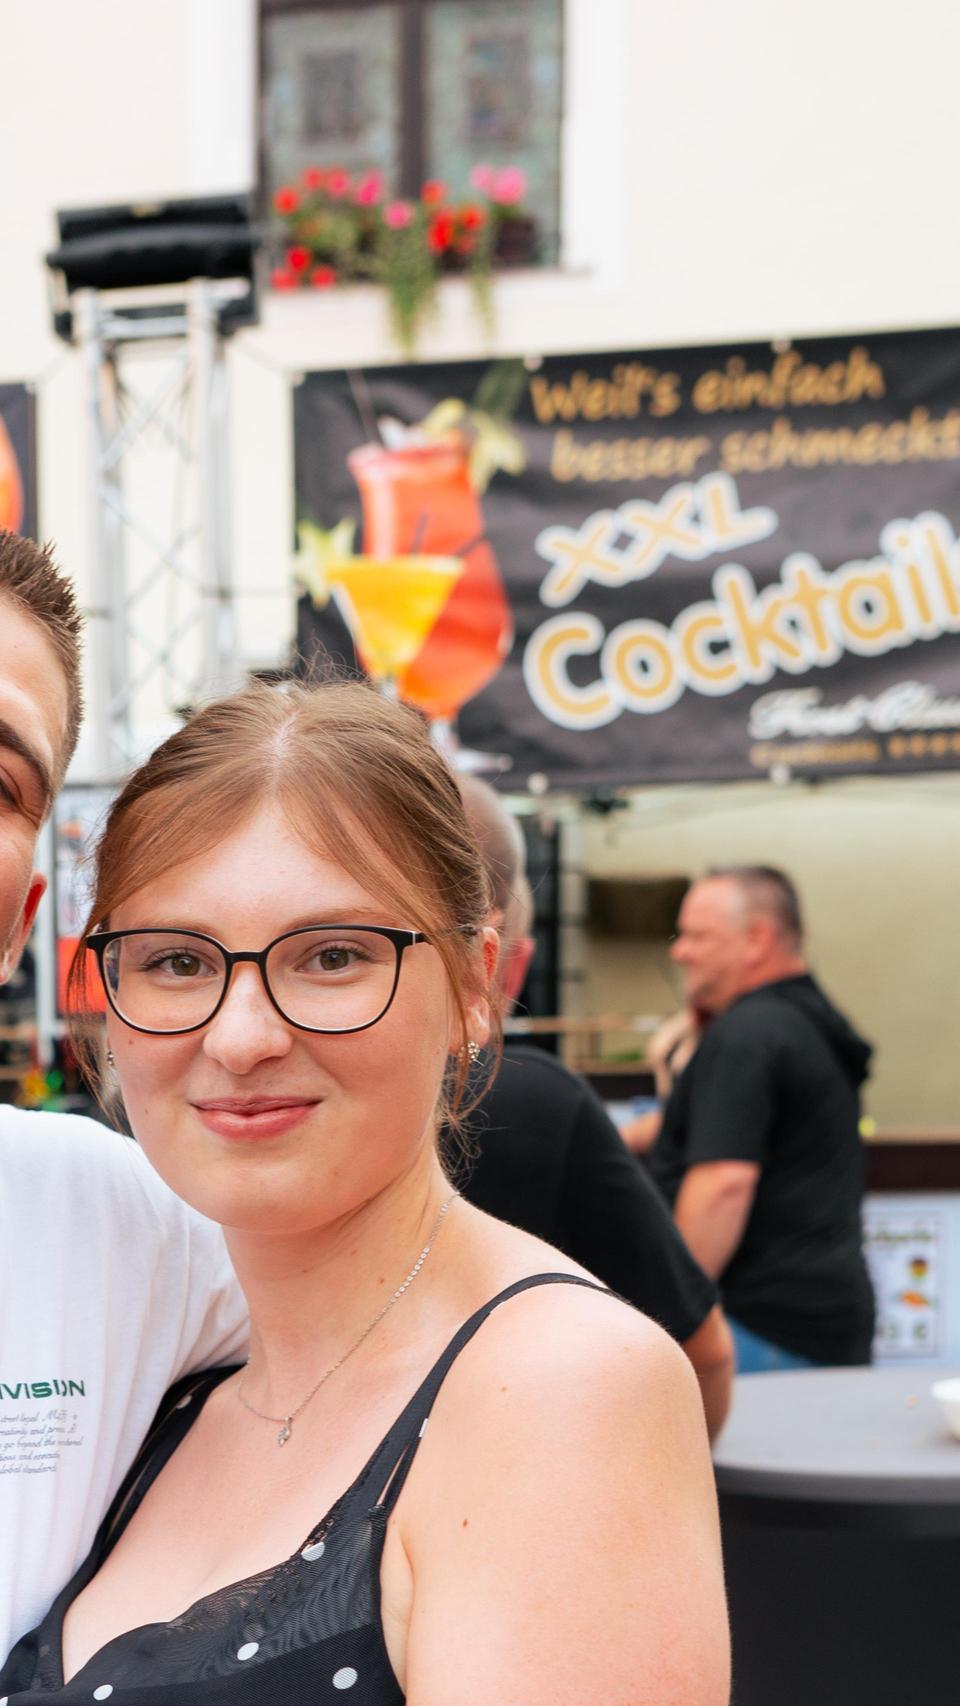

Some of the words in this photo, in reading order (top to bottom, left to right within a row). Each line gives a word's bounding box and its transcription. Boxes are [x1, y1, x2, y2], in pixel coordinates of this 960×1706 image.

[531, 361, 680, 423] Weil's
[692, 346, 885, 413] einfach
[551, 428, 712, 483] besser
[536, 471, 778, 607] XXL
[523, 512, 960, 731] Cocktail
